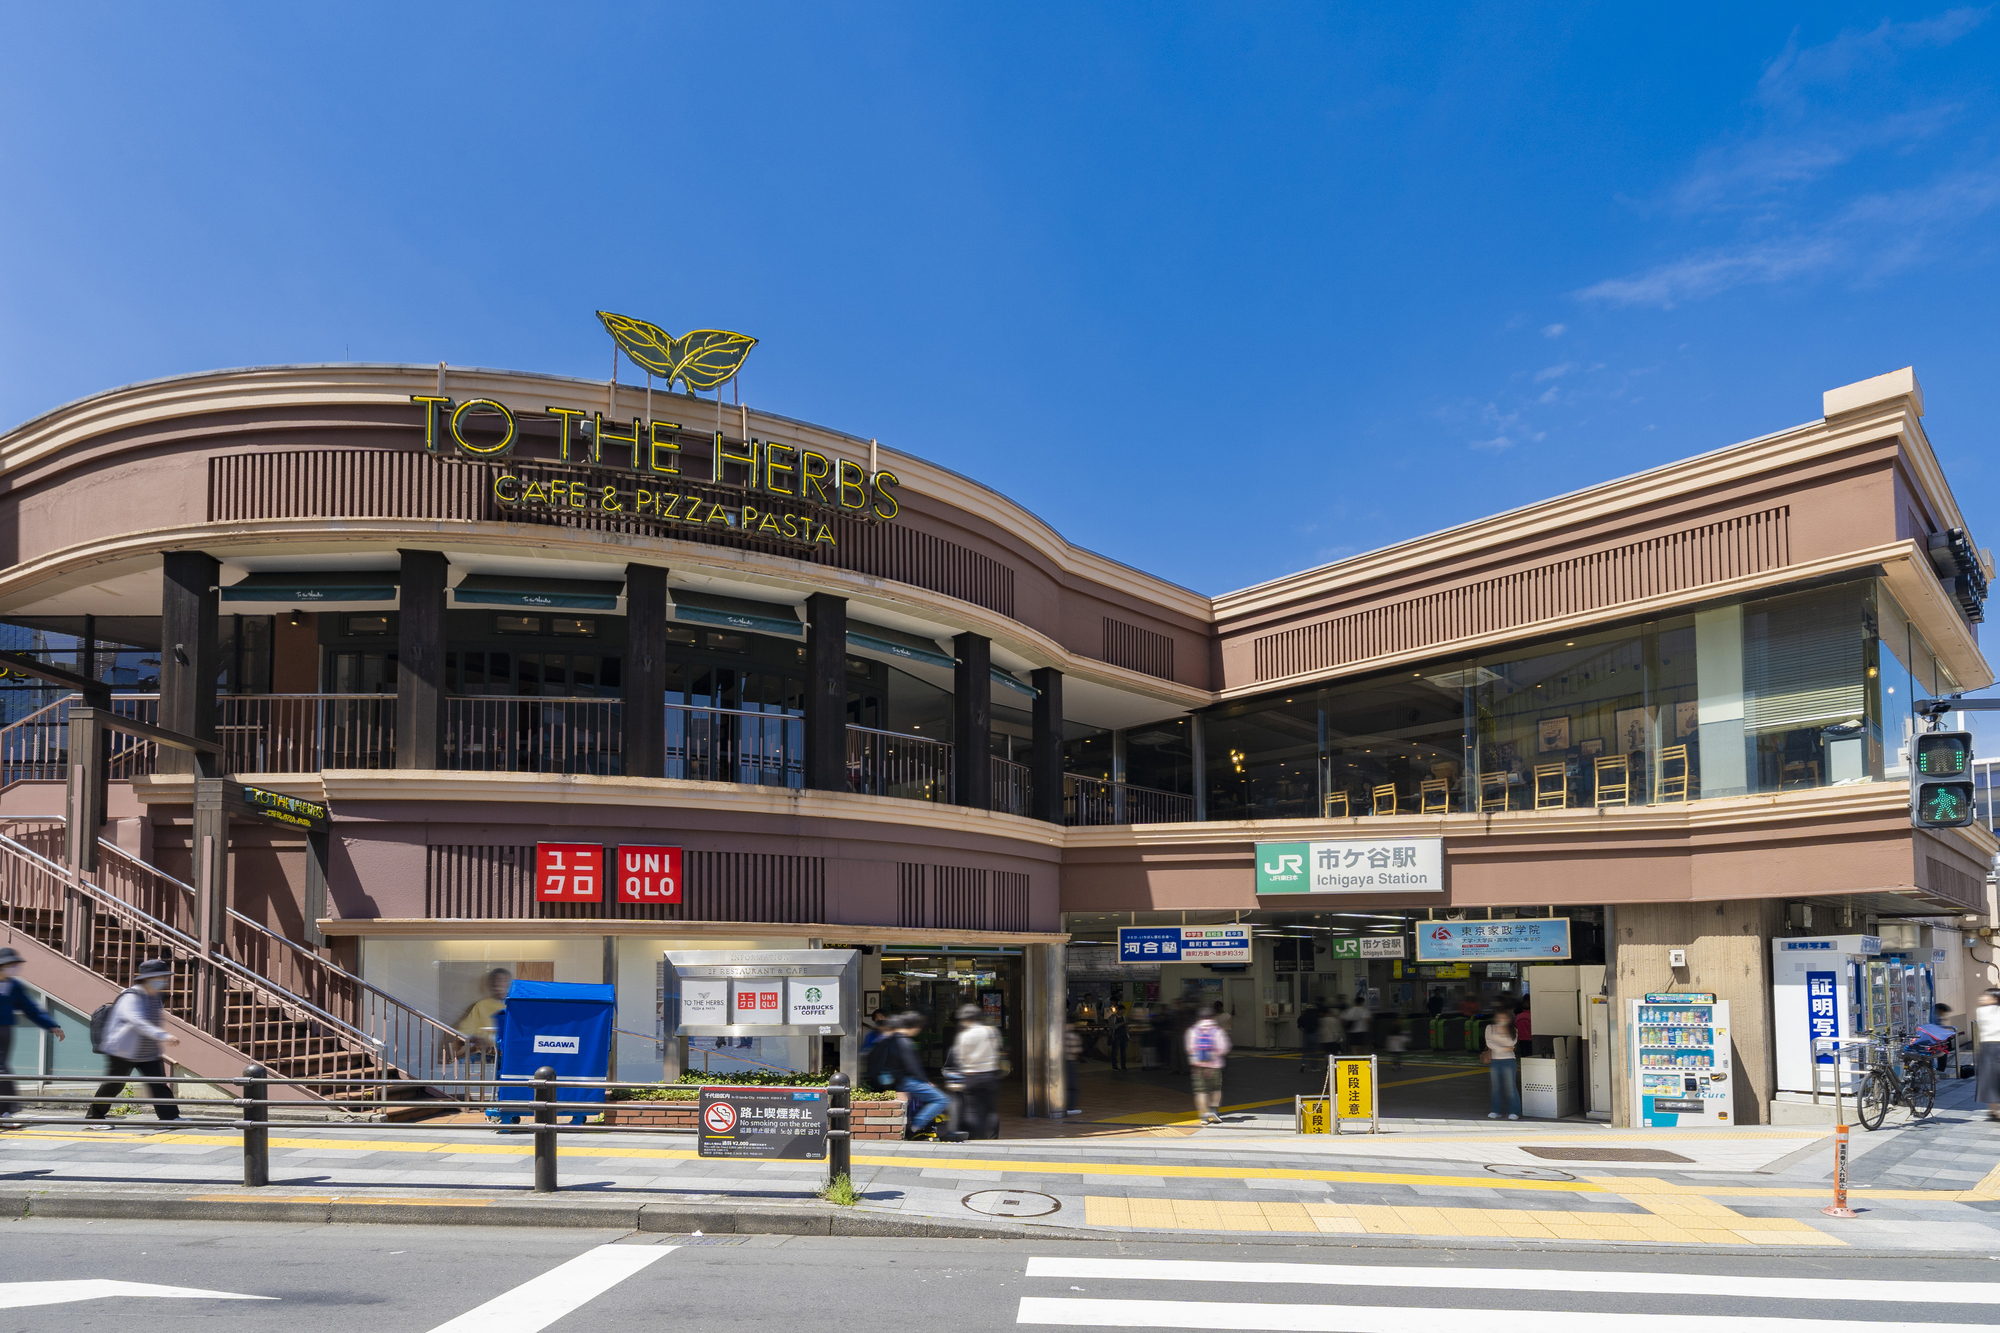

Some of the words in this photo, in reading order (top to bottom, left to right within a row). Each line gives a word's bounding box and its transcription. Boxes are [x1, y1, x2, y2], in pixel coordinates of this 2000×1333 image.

[410, 394, 519, 458] TO
[545, 405, 684, 478] THE
[712, 429, 901, 523] HERBS
[493, 474, 589, 512] CAFE
[601, 485, 623, 514] &
[636, 488, 732, 528] PIZZA
[741, 505, 837, 549] PASTA
[252, 788, 270, 804] TO
[271, 793, 290, 809] THE
[294, 800, 324, 819] HERBS
[626, 853, 670, 873] UNI
[1264, 854, 1303, 874] JR
[1269, 874, 1299, 882] JR東日本
[1317, 874, 1374, 888] Ichigaya
[1378, 872, 1428, 885] Station
[626, 876, 675, 899] QLO
[1461, 925, 1541, 936] 東京家政学院
[1124, 941, 1178, 954] 河合塾
[1336, 940, 1358, 953] JR
[1787, 941, 1831, 950] 証明写真
[730, 954, 789, 962] INFORMATION
[1362, 949, 1383, 957] Ichigaya
[720, 967, 776, 975] RESTAURANT
[1810, 978, 1836, 1057] 証明写真
[537, 1041, 575, 1049] SAGAWA
[1347, 1064, 1360, 1115] 階段注意
[740, 1107, 813, 1120] 路上喫煙禁止
[750, 1120, 778, 1128] smoking
